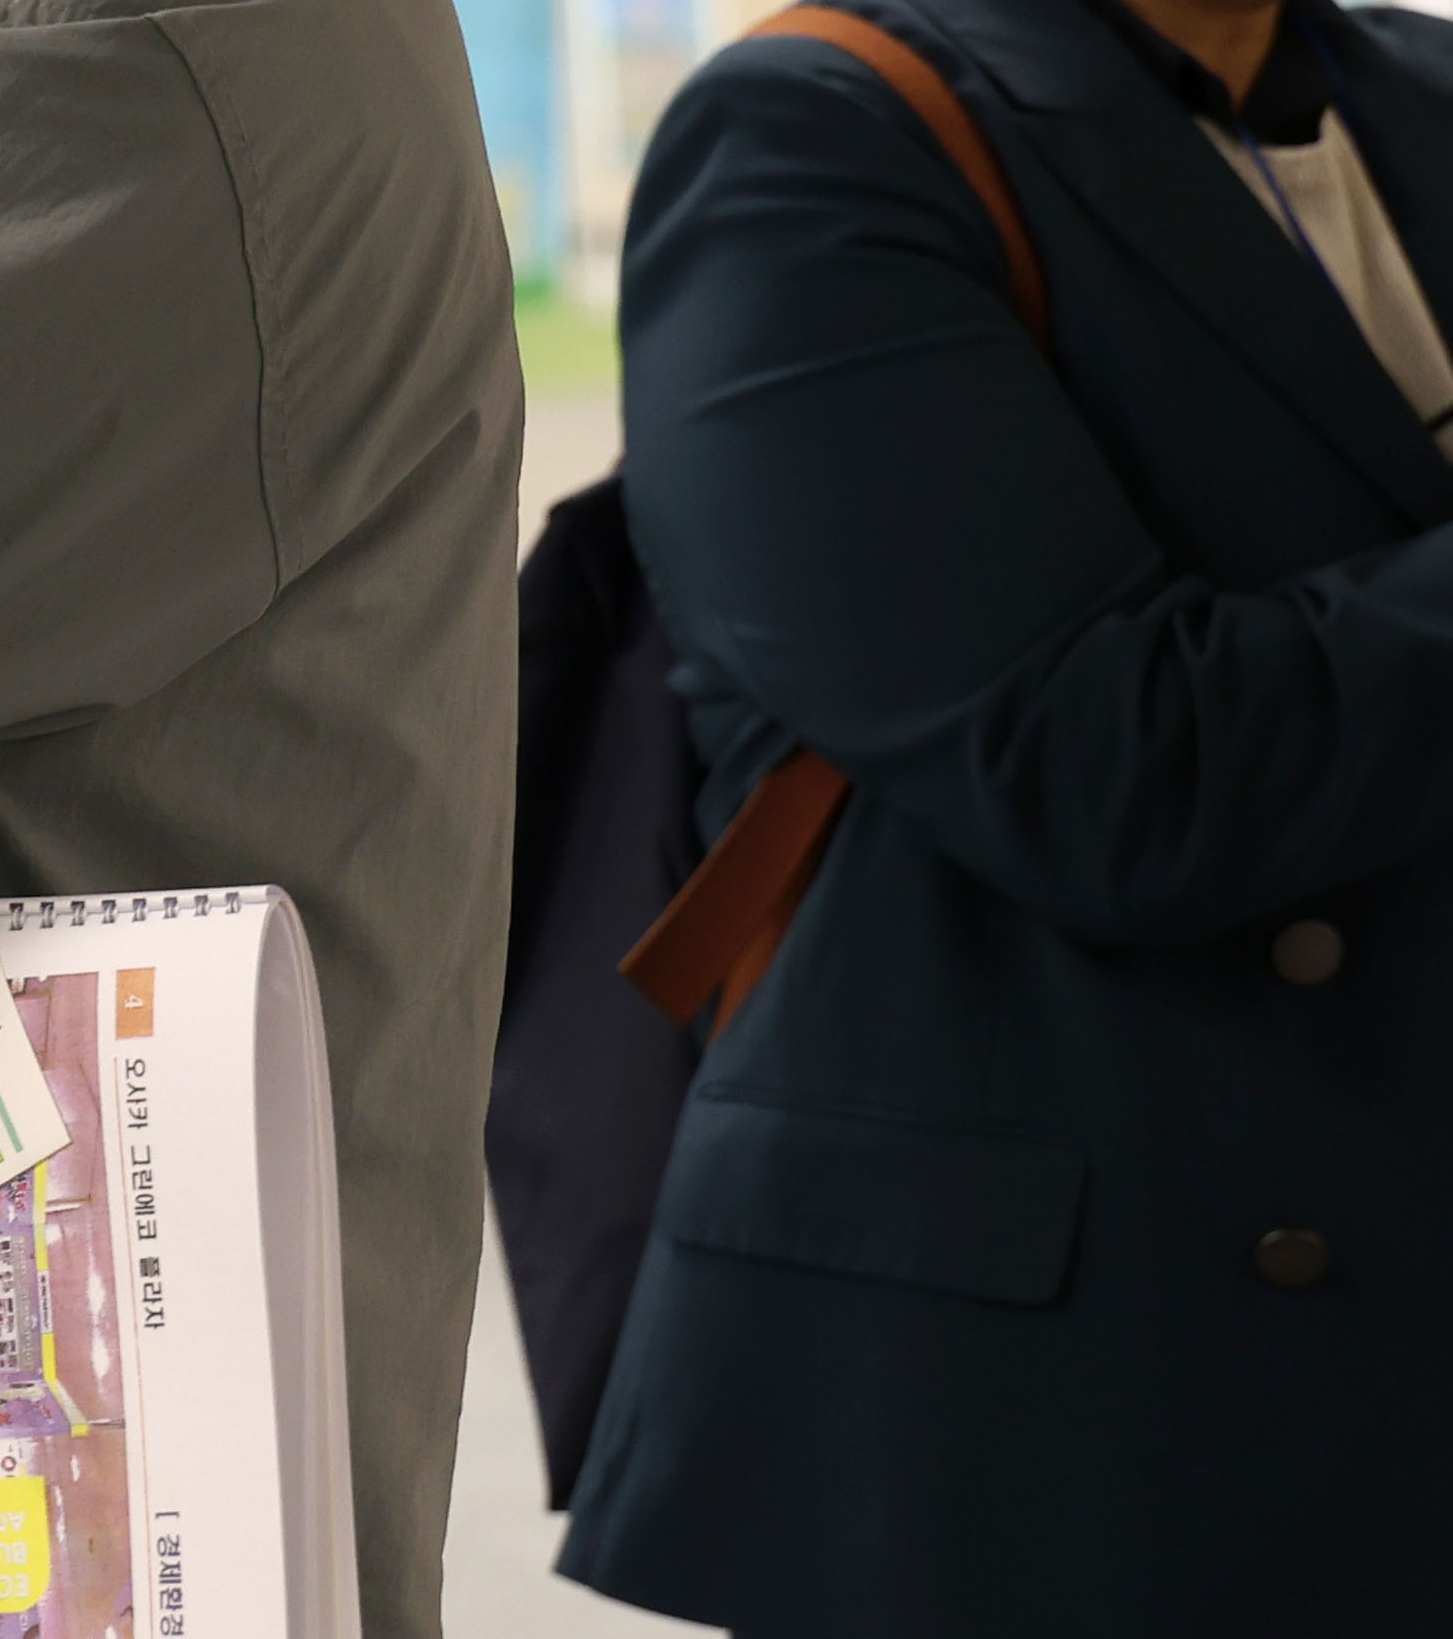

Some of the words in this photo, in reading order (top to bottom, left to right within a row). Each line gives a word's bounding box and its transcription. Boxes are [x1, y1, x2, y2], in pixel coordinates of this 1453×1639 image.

[124, 994, 143, 1008] 4
[125, 1058, 147, 1128] 오사카
[130, 1146, 156, 1239] 그린에코
[139, 1256, 164, 1328] 플라자
[154, 1510, 179, 1518] [
[157, 1536, 183, 1636] 경제환경
